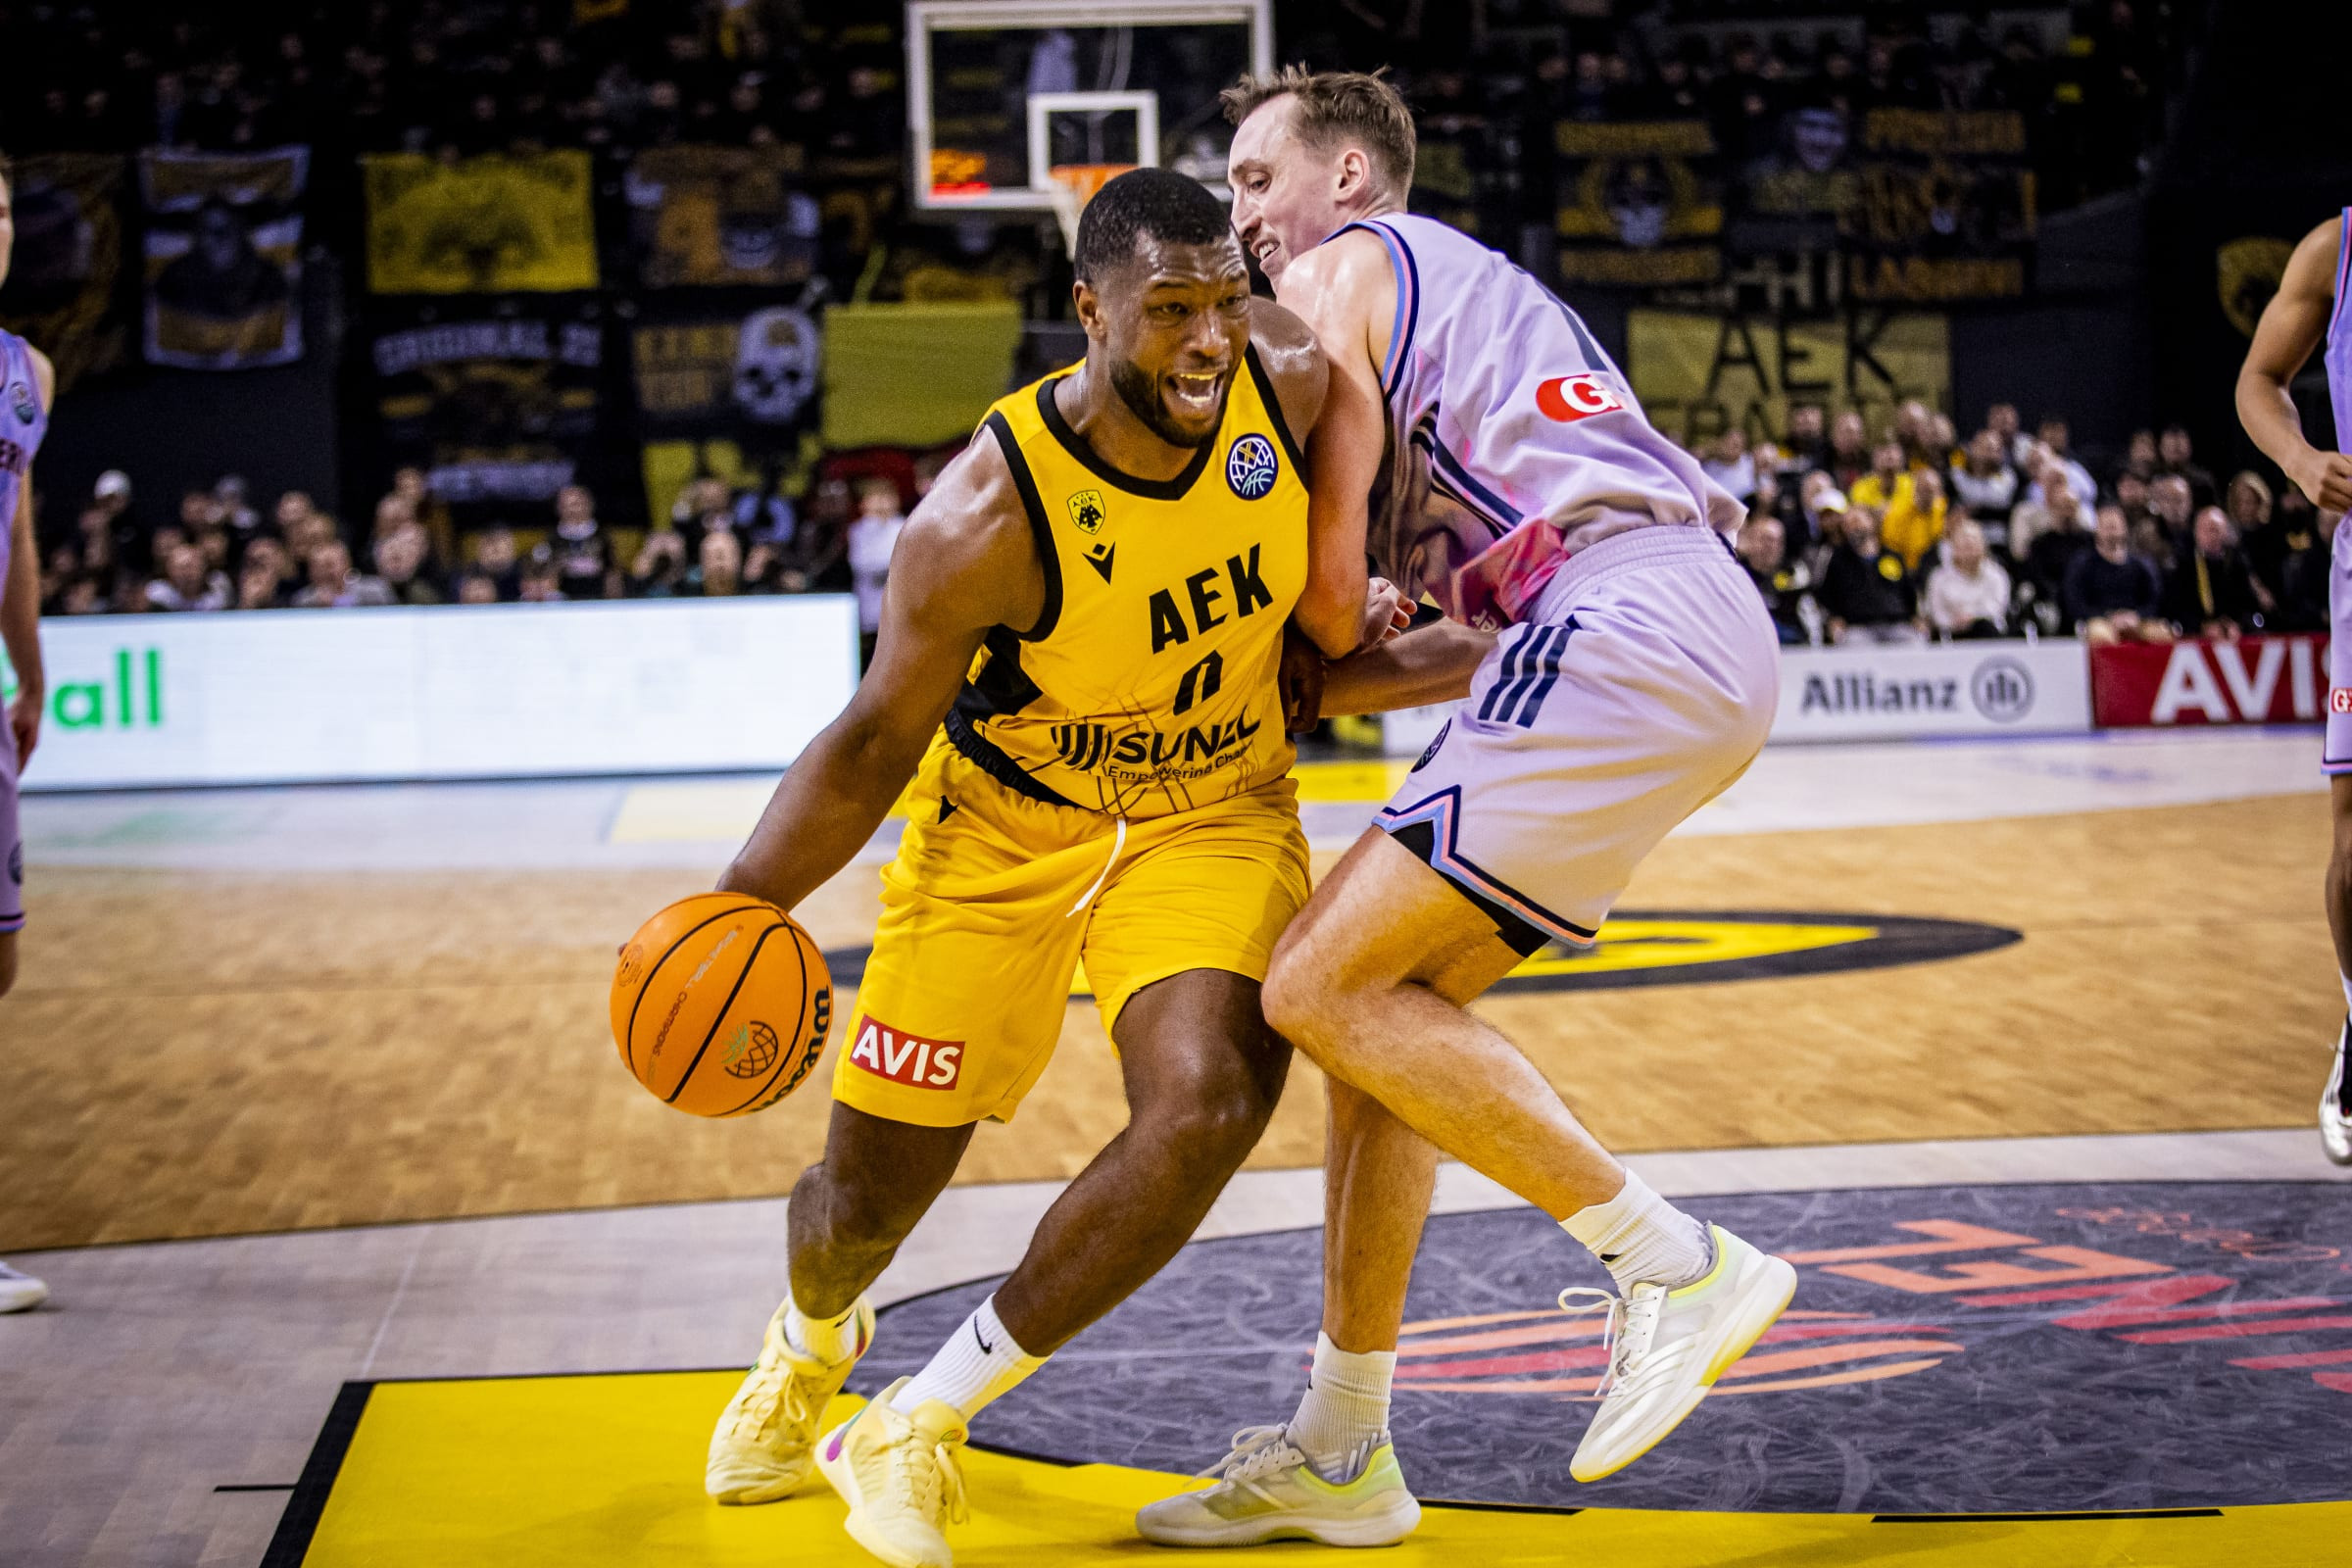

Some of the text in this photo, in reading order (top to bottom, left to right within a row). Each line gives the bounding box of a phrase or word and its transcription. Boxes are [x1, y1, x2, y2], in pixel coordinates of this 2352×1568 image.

[1706, 310, 1895, 396] AEK
[1149, 542, 1274, 655] AEK
[0, 647, 161, 727] all
[1801, 670, 1958, 716] Allianz
[2149, 636, 2330, 725] AVI
[852, 1024, 957, 1087] AVIS
